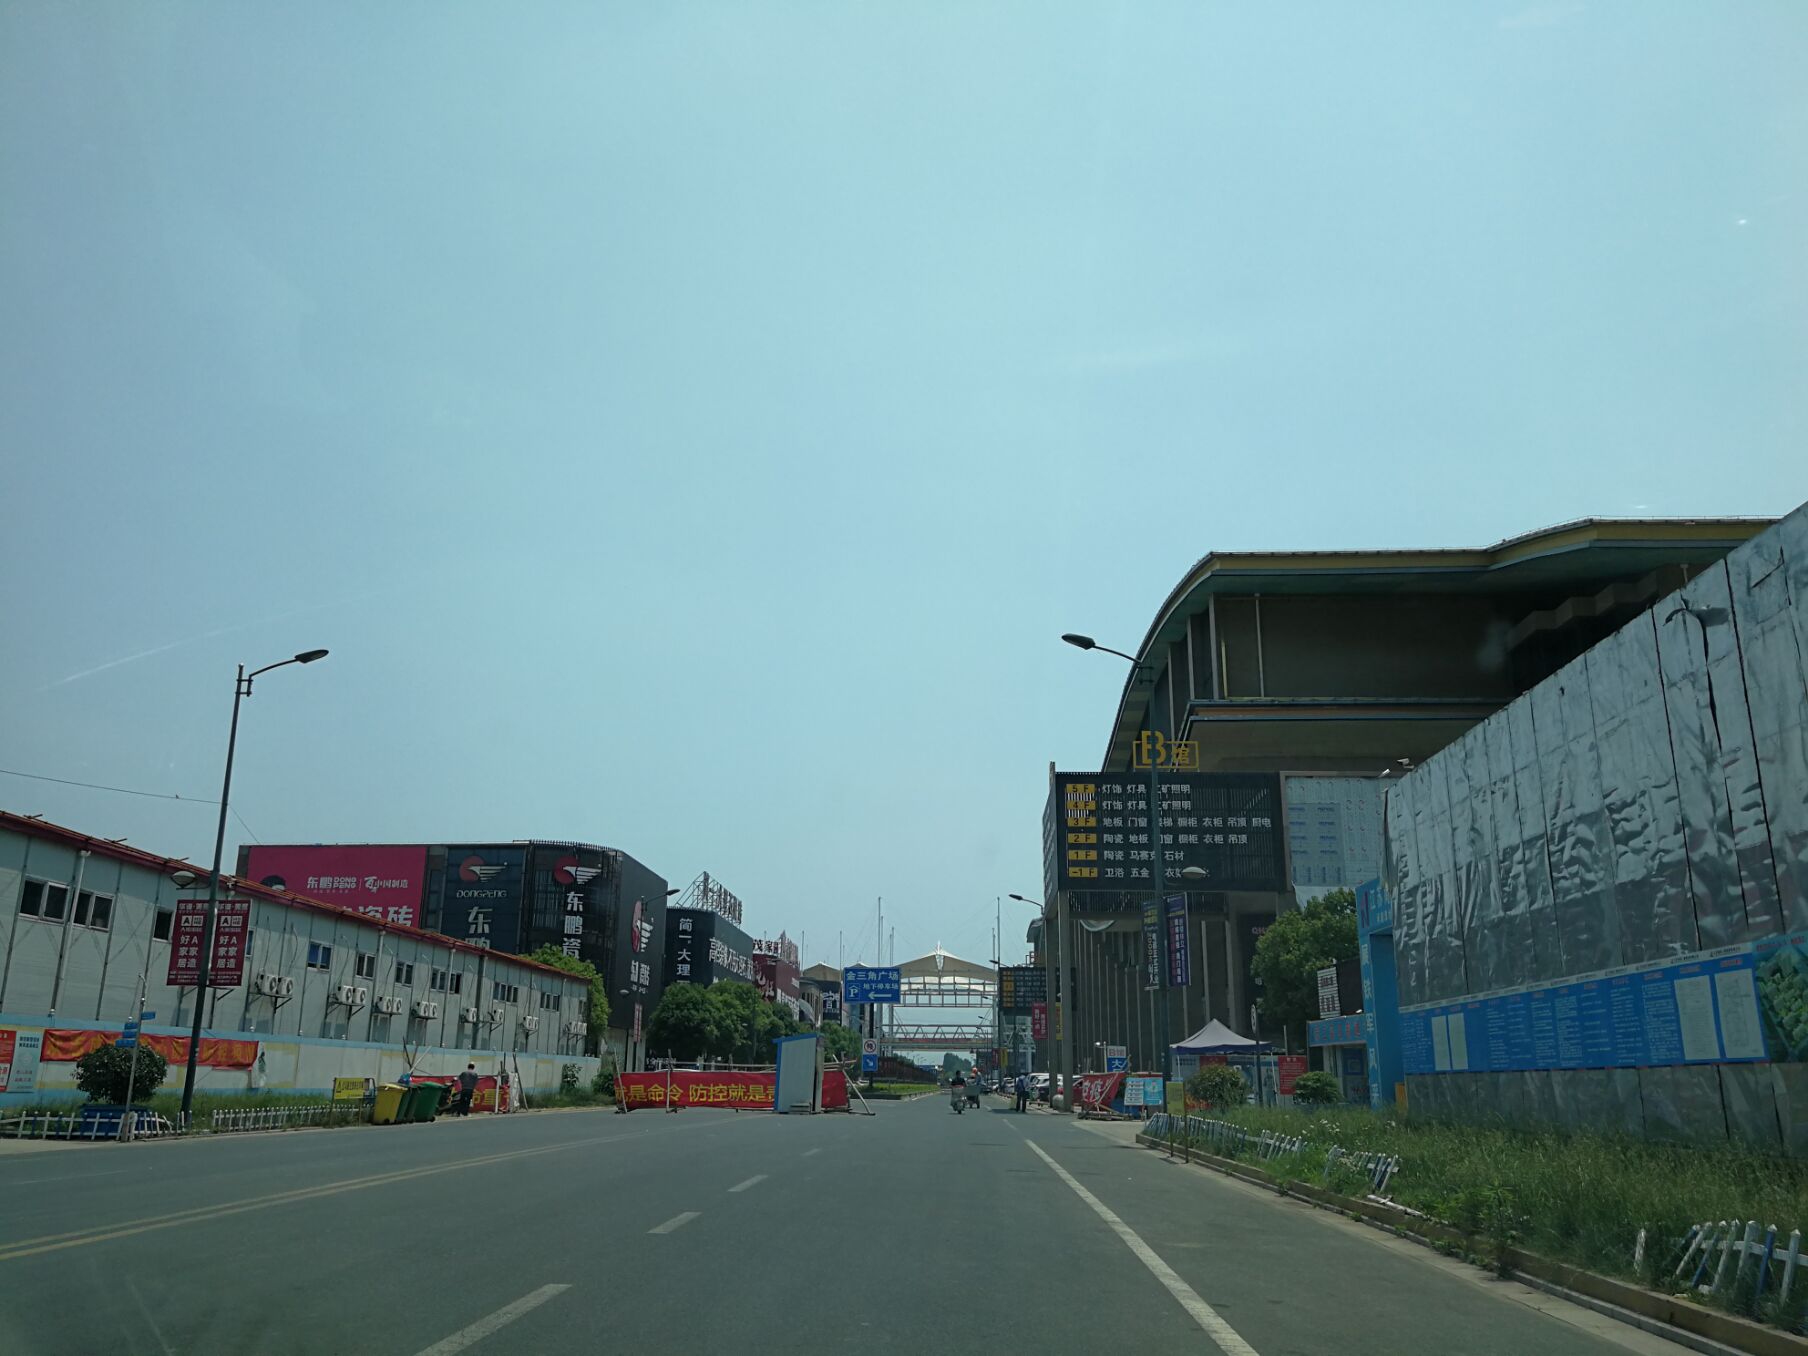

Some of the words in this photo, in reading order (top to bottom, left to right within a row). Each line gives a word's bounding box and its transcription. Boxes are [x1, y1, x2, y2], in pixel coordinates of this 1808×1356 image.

[1102, 784, 1122, 794] 灯饰
[1127, 784, 1147, 794] 灯具
[1102, 801, 1123, 810] 灯饰
[1127, 801, 1147, 810] 灯具
[1103, 817, 1123, 828] 地板
[1128, 817, 1148, 828] 门窗
[1202, 817, 1223, 828] 衣柜
[1227, 817, 1247, 828] 吊顶
[1104, 834, 1124, 844] 陶瓷
[1129, 834, 1149, 844] 地板
[1203, 834, 1224, 844] 衣柜
[1228, 834, 1248, 844] 吊顶
[1104, 850, 1124, 861] 陶瓷
[1164, 850, 1184, 861] 石材
[1105, 867, 1125, 878] 卫浴
[1130, 868, 1150, 878] 五金
[307, 876, 333, 889] 东鹏
